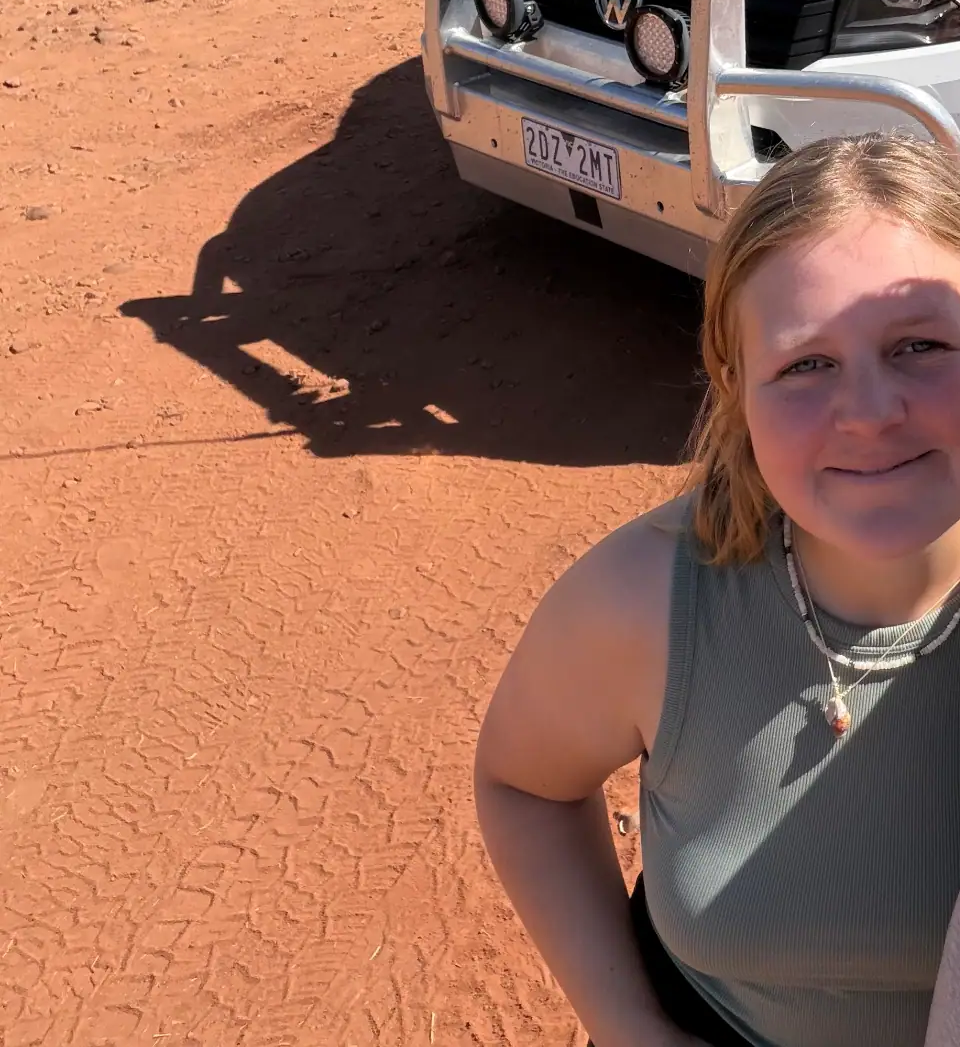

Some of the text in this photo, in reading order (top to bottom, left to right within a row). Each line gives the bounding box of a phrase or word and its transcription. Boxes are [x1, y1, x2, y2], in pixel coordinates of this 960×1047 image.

[526, 126, 613, 186] 2DZ 2MT
[558, 168, 568, 178] THE
[568, 171, 598, 188] EDUCATION
[598, 182, 615, 195] STATE
